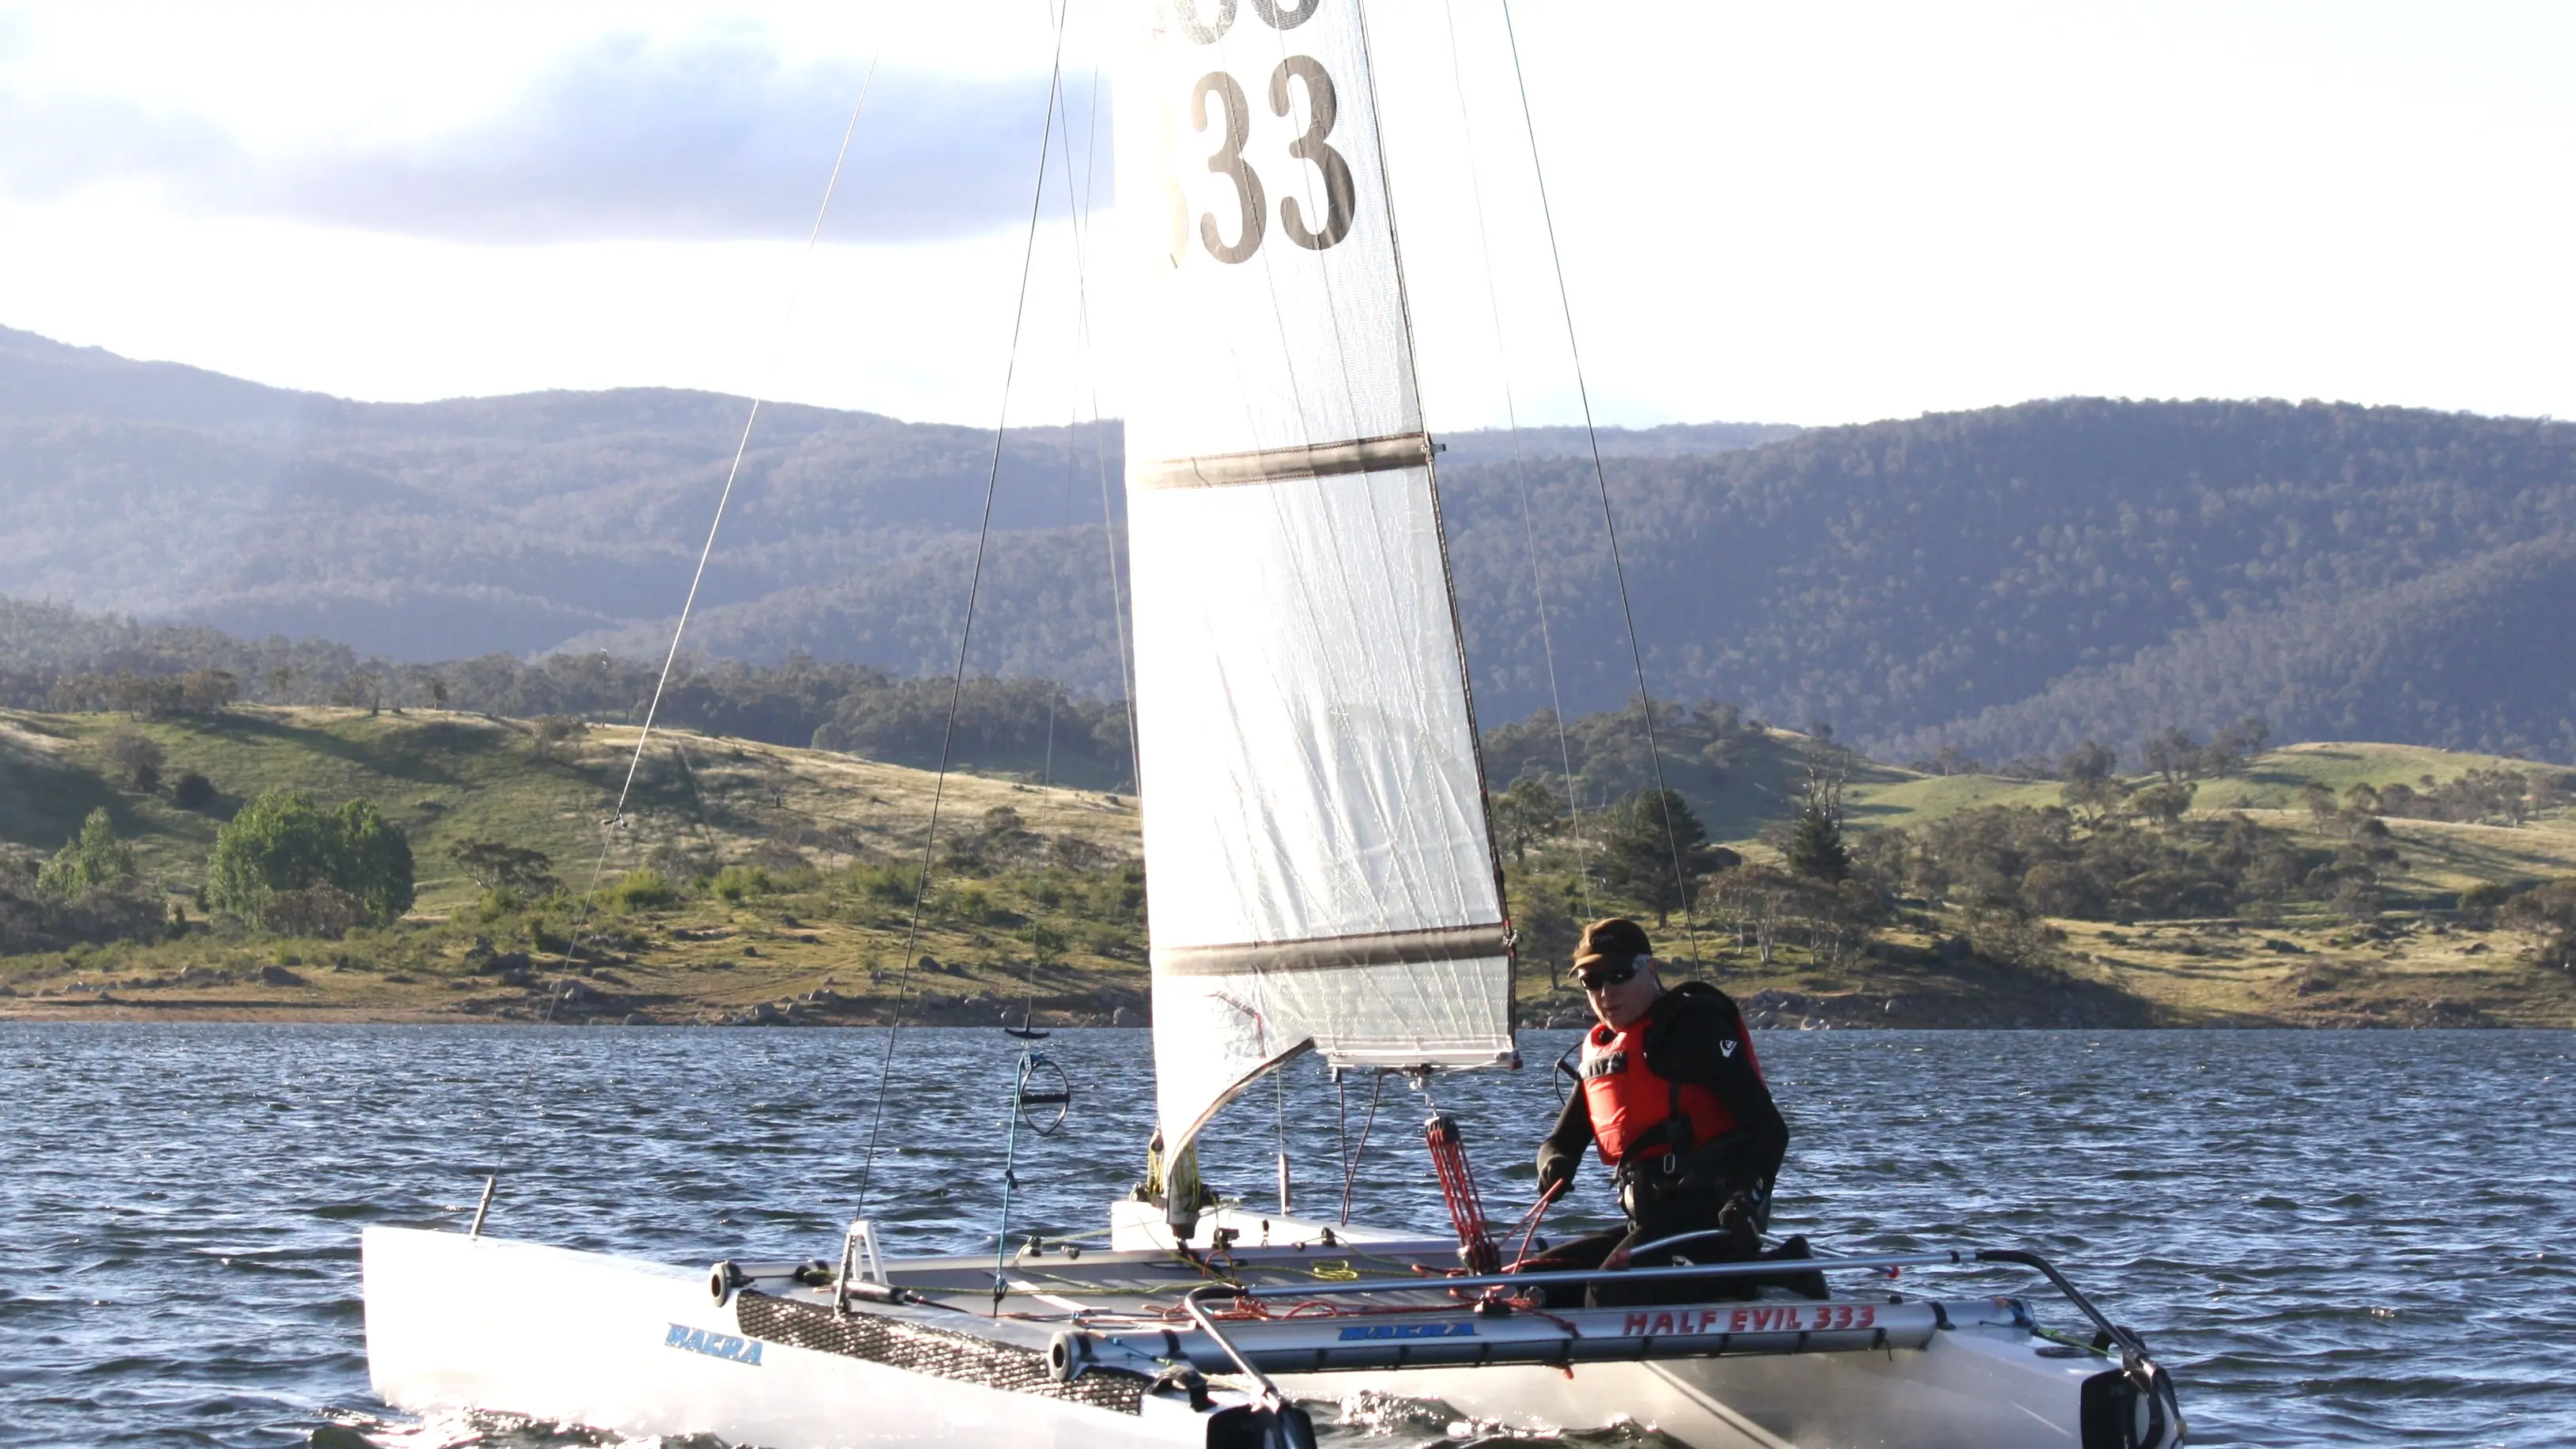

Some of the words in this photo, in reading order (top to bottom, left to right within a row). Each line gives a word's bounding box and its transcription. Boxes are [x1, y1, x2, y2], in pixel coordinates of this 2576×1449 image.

[1622, 1311, 1717, 1336] HALF
[1728, 1307, 1803, 1333] EVIL
[1811, 1305, 1875, 1330] 333
